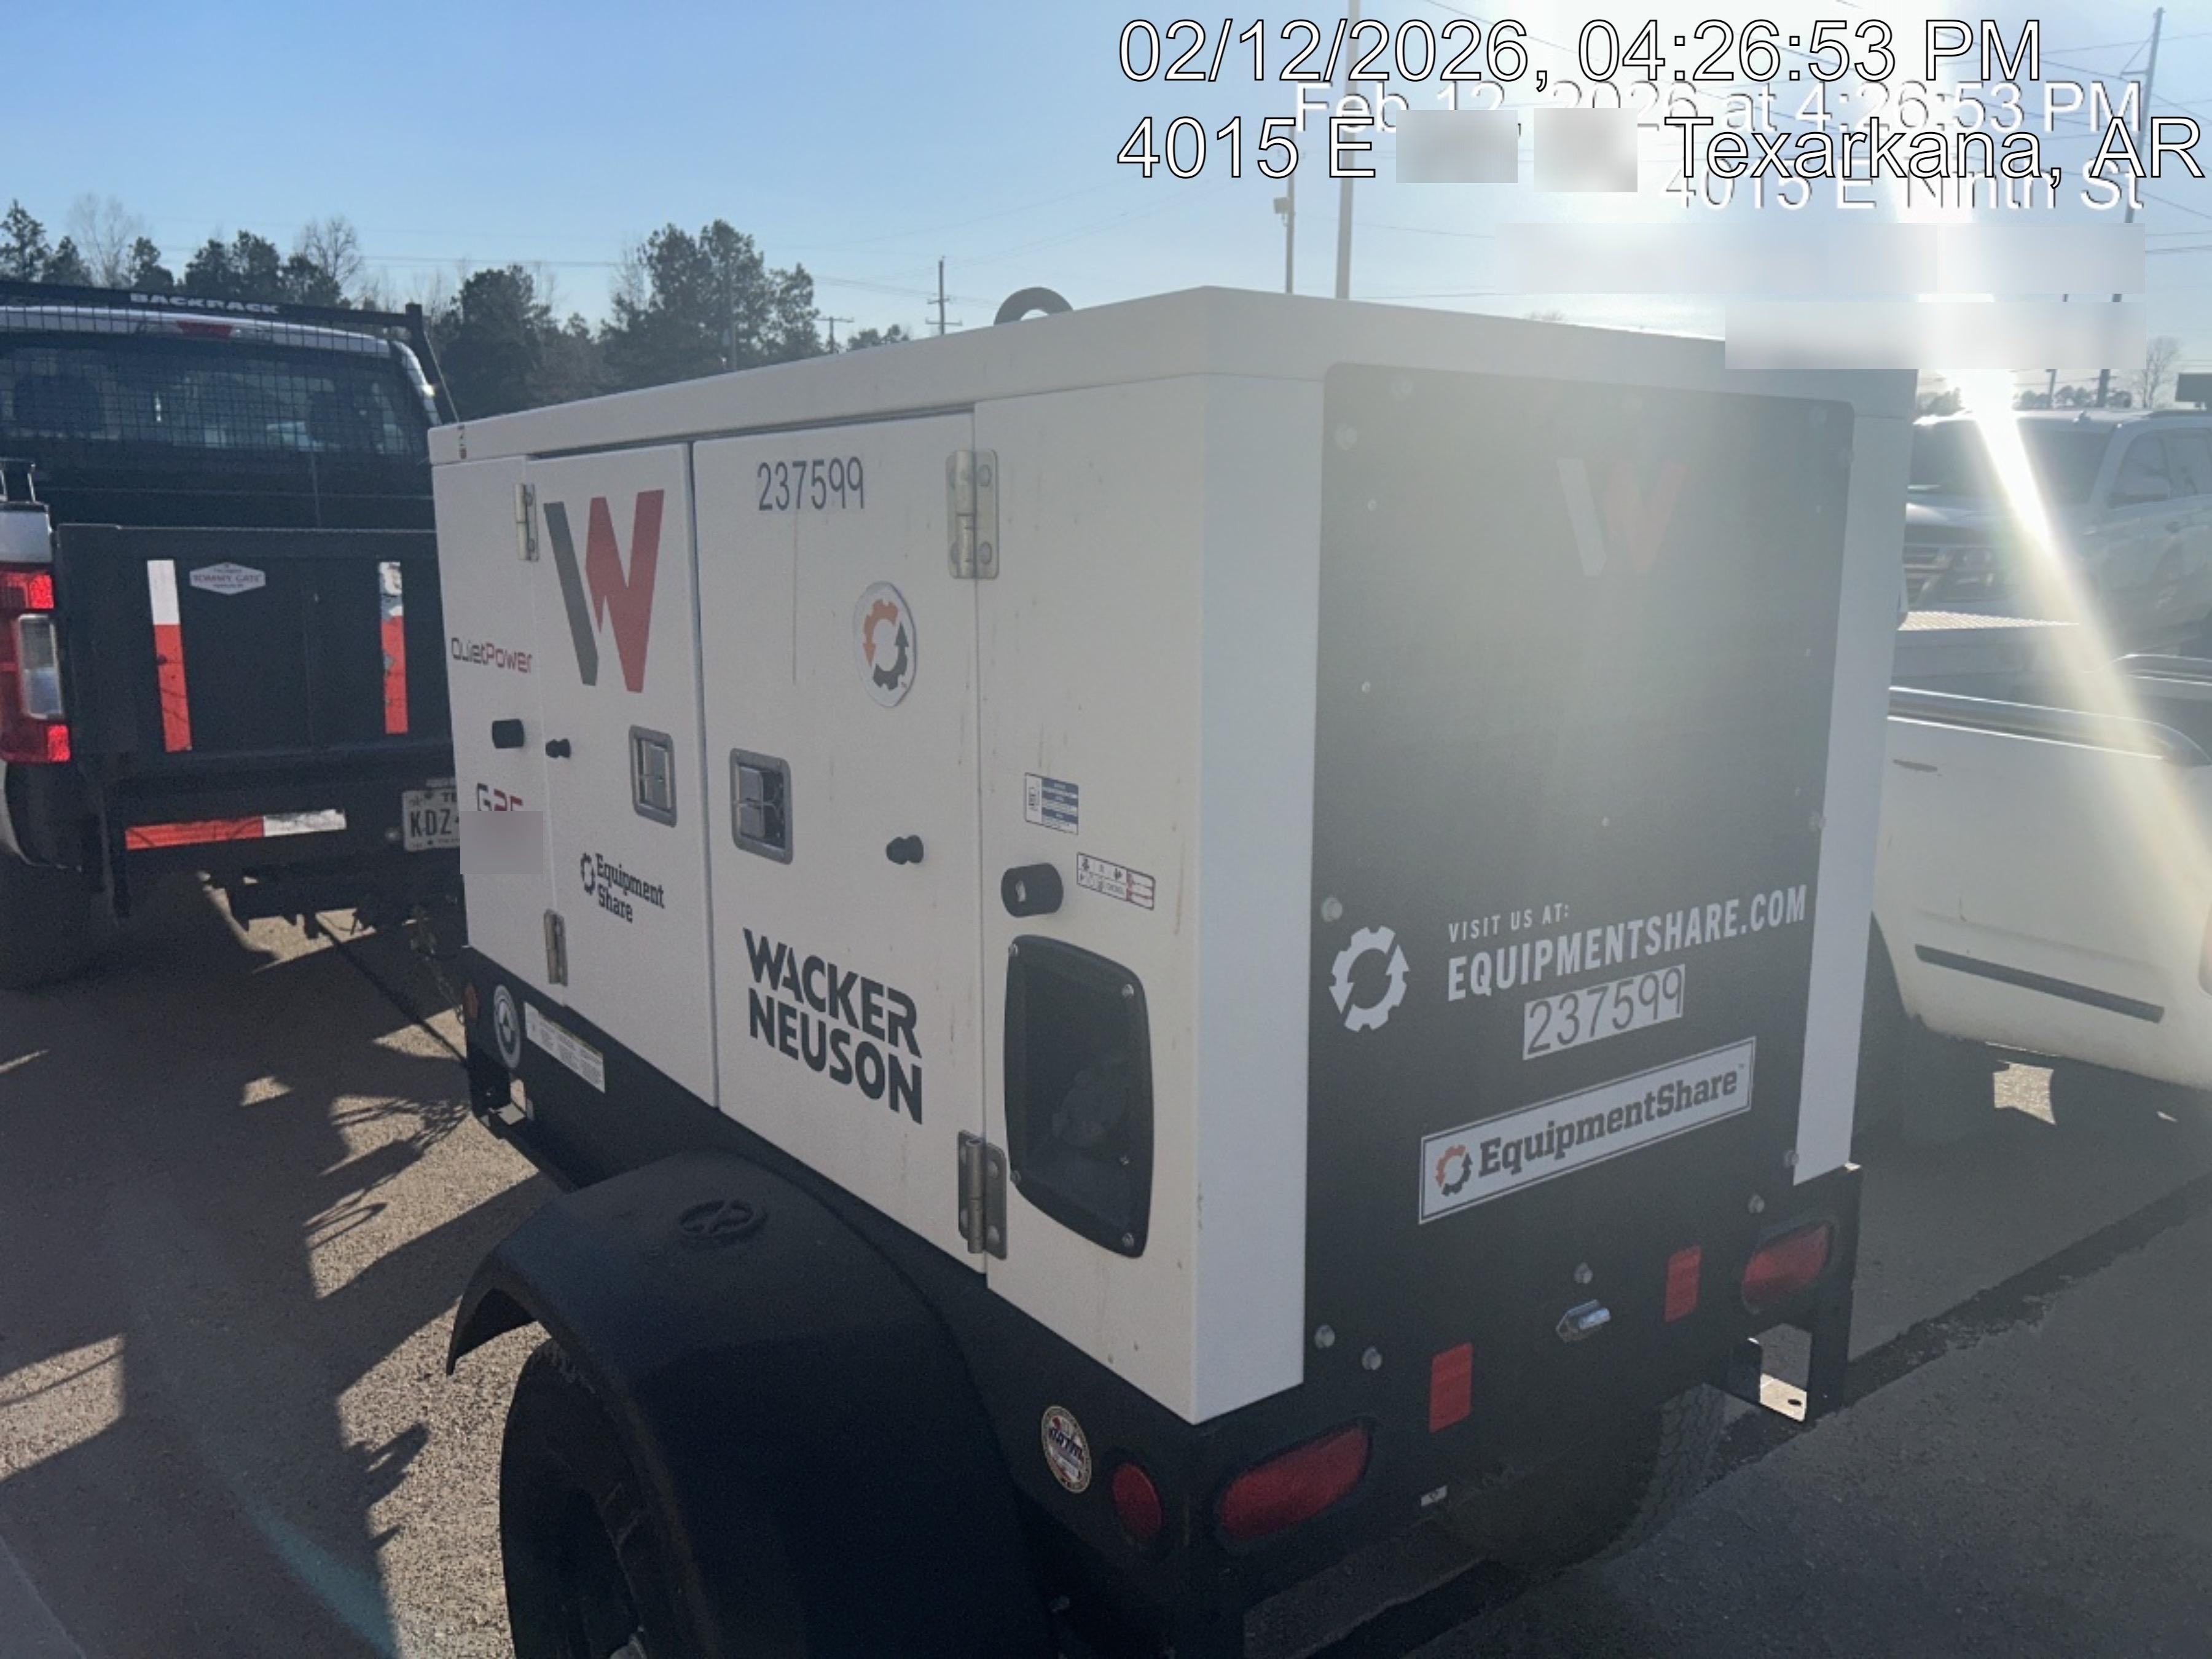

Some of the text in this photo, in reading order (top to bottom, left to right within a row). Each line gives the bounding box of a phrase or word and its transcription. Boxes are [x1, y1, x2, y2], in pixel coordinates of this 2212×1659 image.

[130, 292, 279, 314] BACKRACK
[757, 457, 865, 511] 237599
[595, 853, 665, 909] Equipment
[598, 883, 633, 924] Share
[1448, 903, 1570, 943] VISIT US AT:
[1448, 885, 1807, 1002] EQUIPMENTSHARE.COM
[743, 927, 922, 1058] WACKER
[1528, 968, 1683, 1054] 237599
[748, 987, 923, 1125] NEUSON
[1478, 1069, 1737, 1177] EquipmentShare
